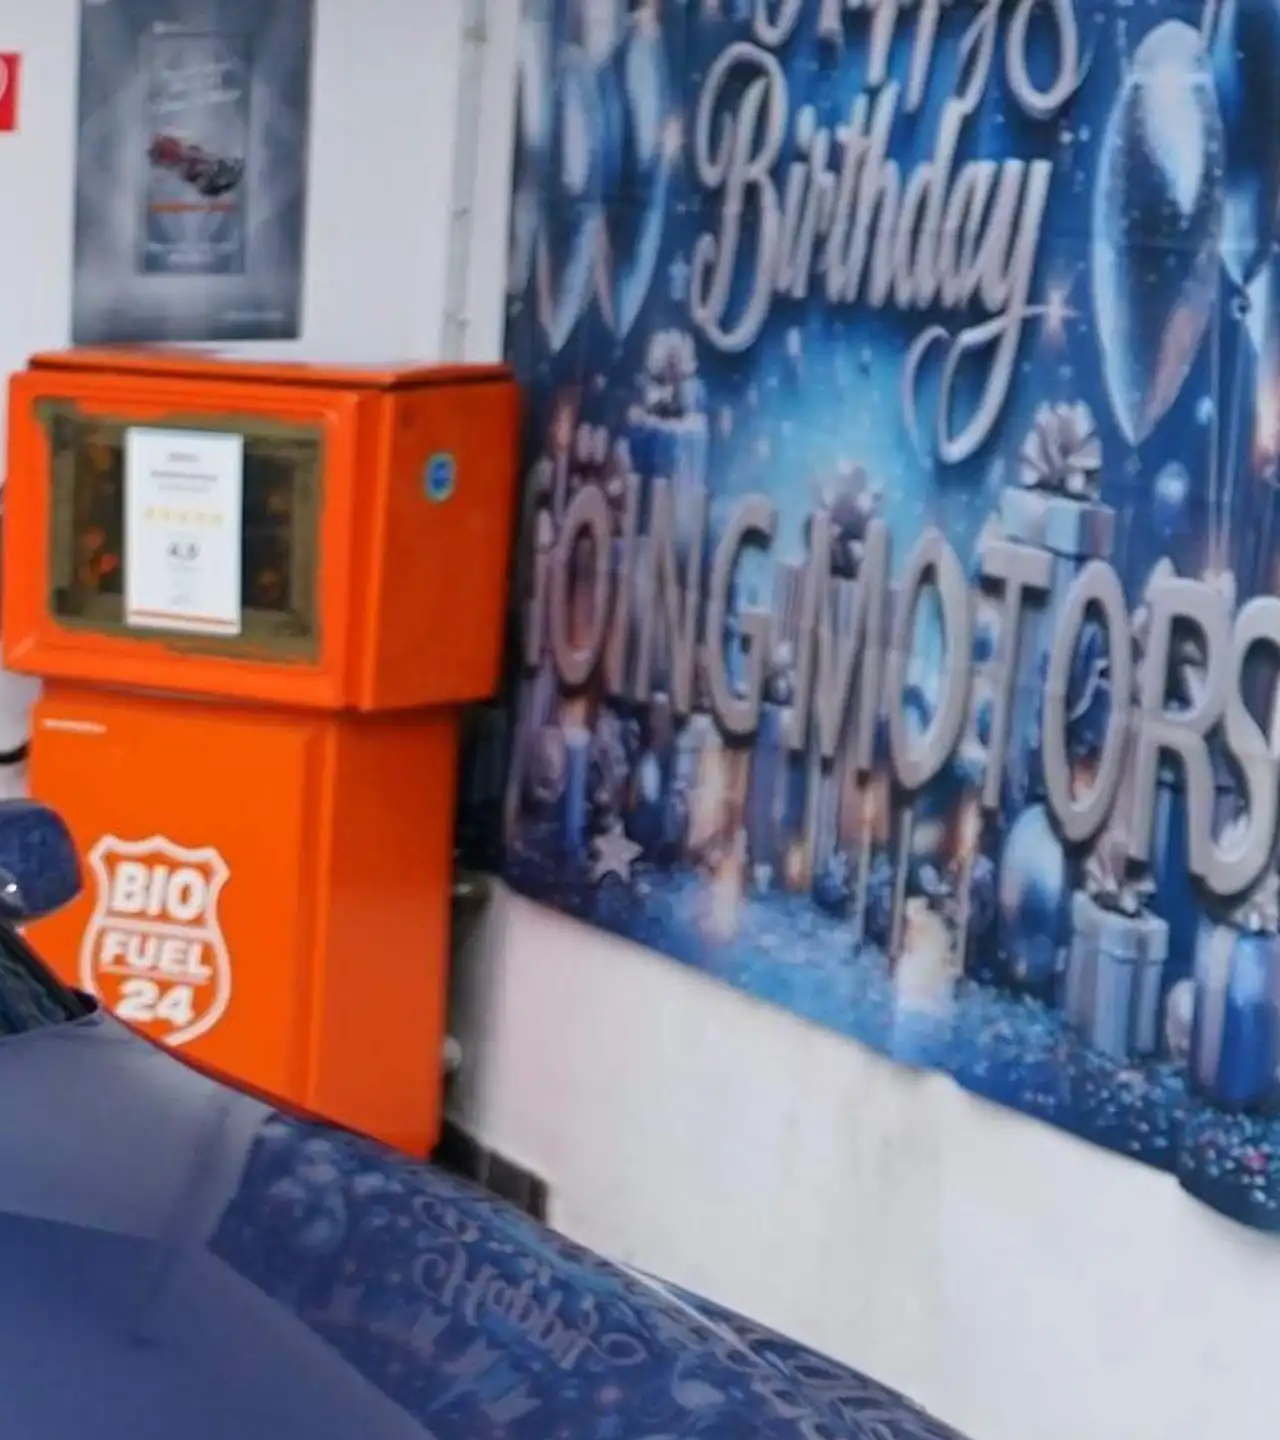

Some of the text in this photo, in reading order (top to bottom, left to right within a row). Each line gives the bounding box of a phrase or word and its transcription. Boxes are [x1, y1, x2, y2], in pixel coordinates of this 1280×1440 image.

[690, 42, 1052, 464] Birthday
[787, 508, 1280, 897] MOTORS
[112, 861, 207, 921] BIO
[100, 931, 213, 978] FUEL
[115, 980, 194, 1026] 24
